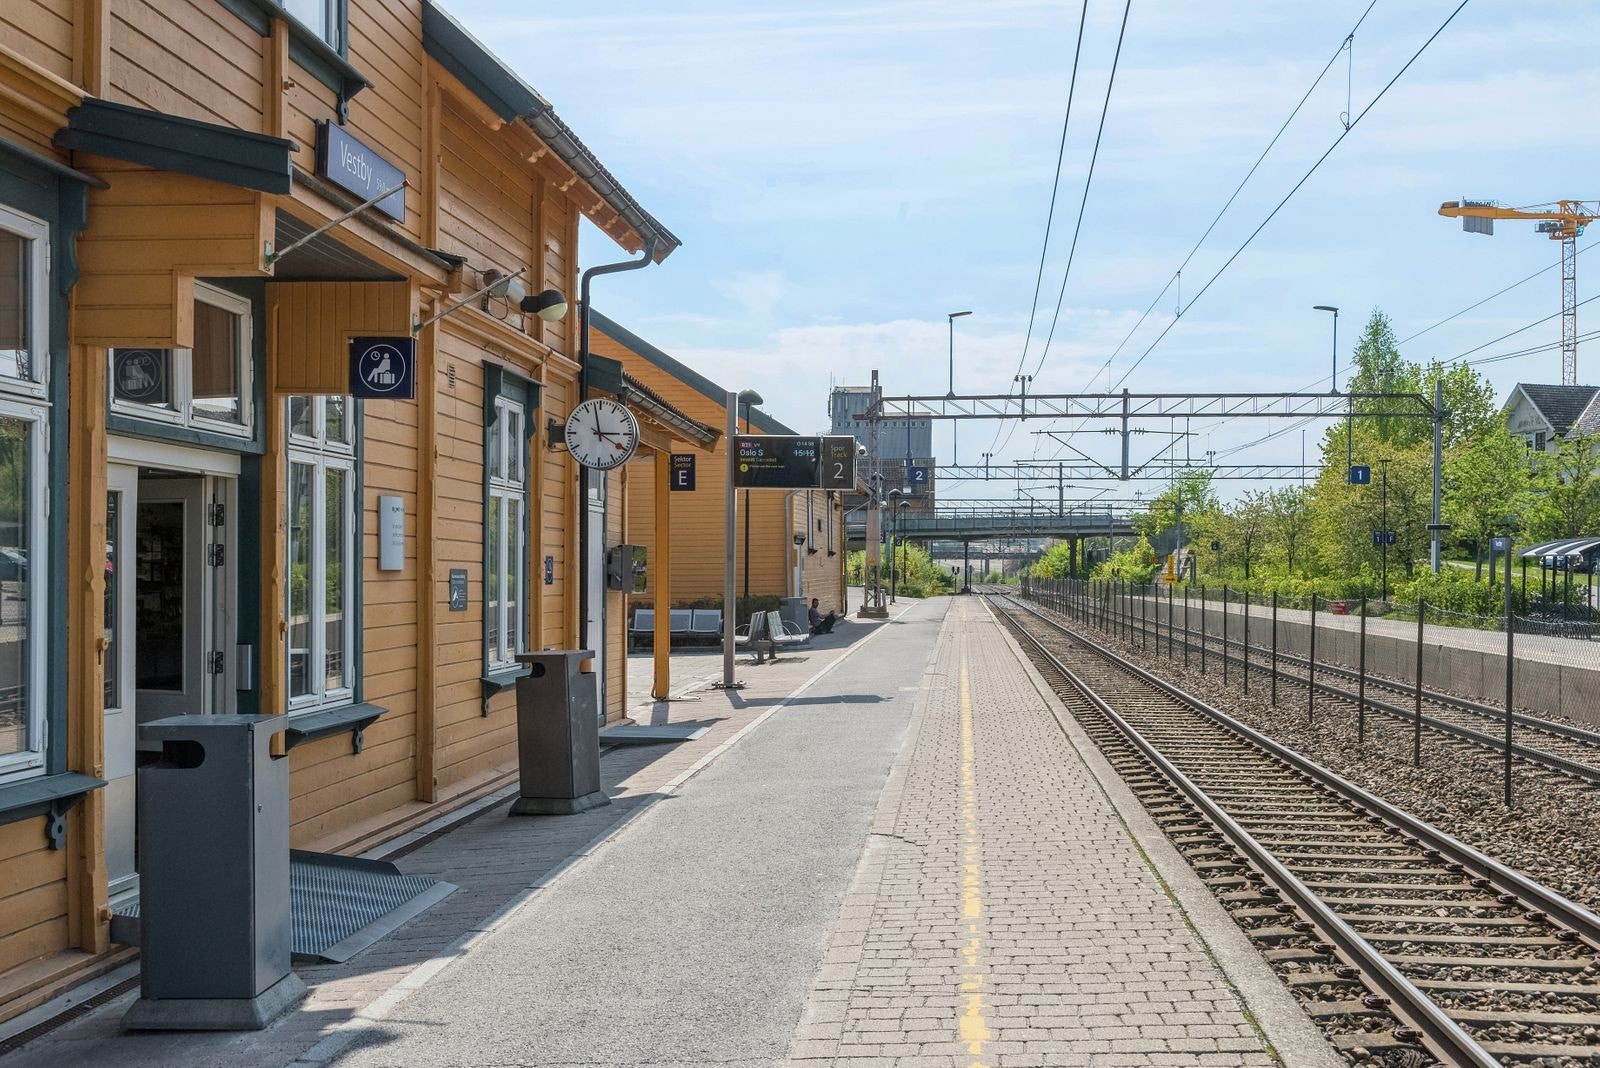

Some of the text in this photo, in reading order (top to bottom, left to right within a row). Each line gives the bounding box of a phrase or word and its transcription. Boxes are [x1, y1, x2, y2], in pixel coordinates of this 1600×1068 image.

[340, 140, 372, 190] Vestby
[793, 449, 815, 457] 15:12
[831, 444, 845, 452] Spor
[674, 455, 692, 463] Sektor
[833, 462, 844, 479] 2
[915, 470, 923, 481] 2
[1357, 470, 1363, 480] 1
[679, 470, 688, 485] E
